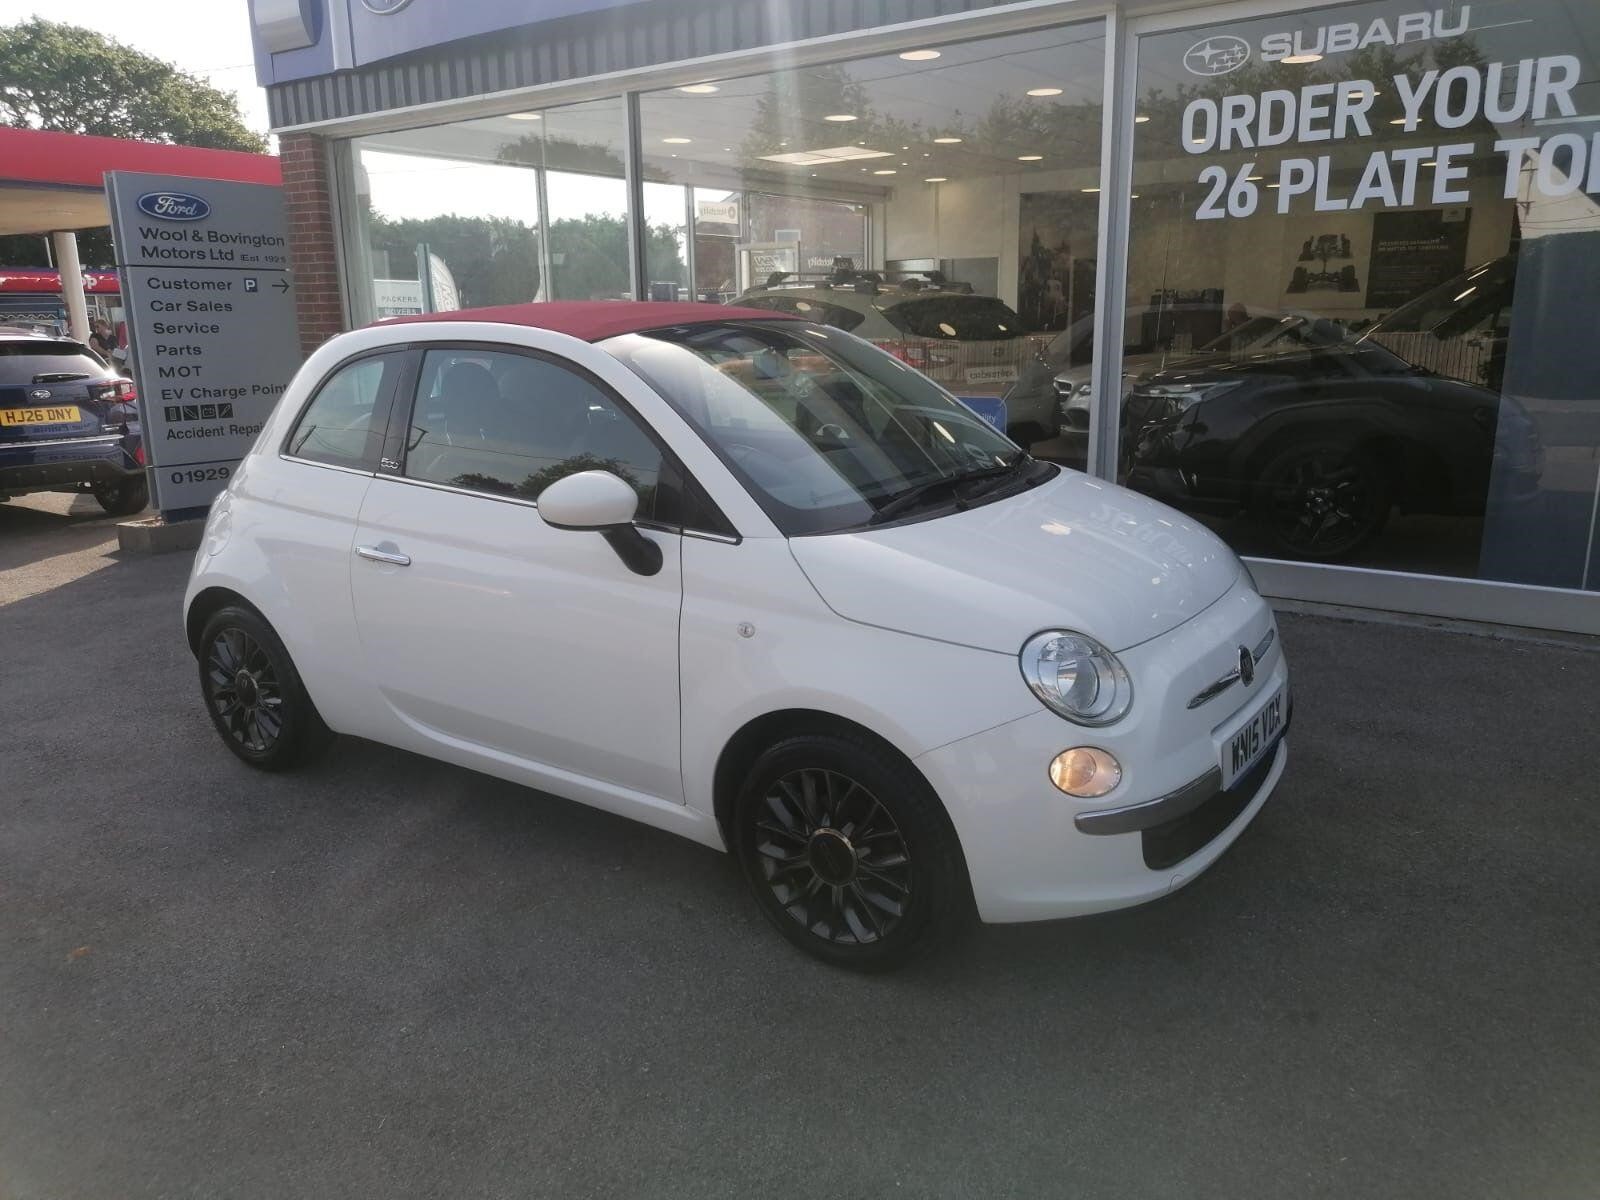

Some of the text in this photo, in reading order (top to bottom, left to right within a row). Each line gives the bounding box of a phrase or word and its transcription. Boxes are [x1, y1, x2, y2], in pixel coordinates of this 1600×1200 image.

[1260, 5, 1471, 62] SUBARU
[1181, 55, 1581, 154] ORDER YOUR
[1195, 162, 1259, 220] 26
[1277, 143, 1475, 214] PLATE
[139, 227, 285, 248] Wool & Bovington
[141, 246, 206, 260] Motors
[210, 248, 234, 261] Ltd
[147, 277, 233, 291] Customer
[150, 300, 233, 312] Car Sales
[153, 322, 220, 335] Service
[156, 345, 202, 356] Parts
[159, 366, 202, 378] MOT
[161, 384, 288, 400] EV Charge Point
[5, 408, 73, 424] HJ26 DNY
[166, 422, 264, 440] Accident Repai
[171, 467, 230, 485] 01929
